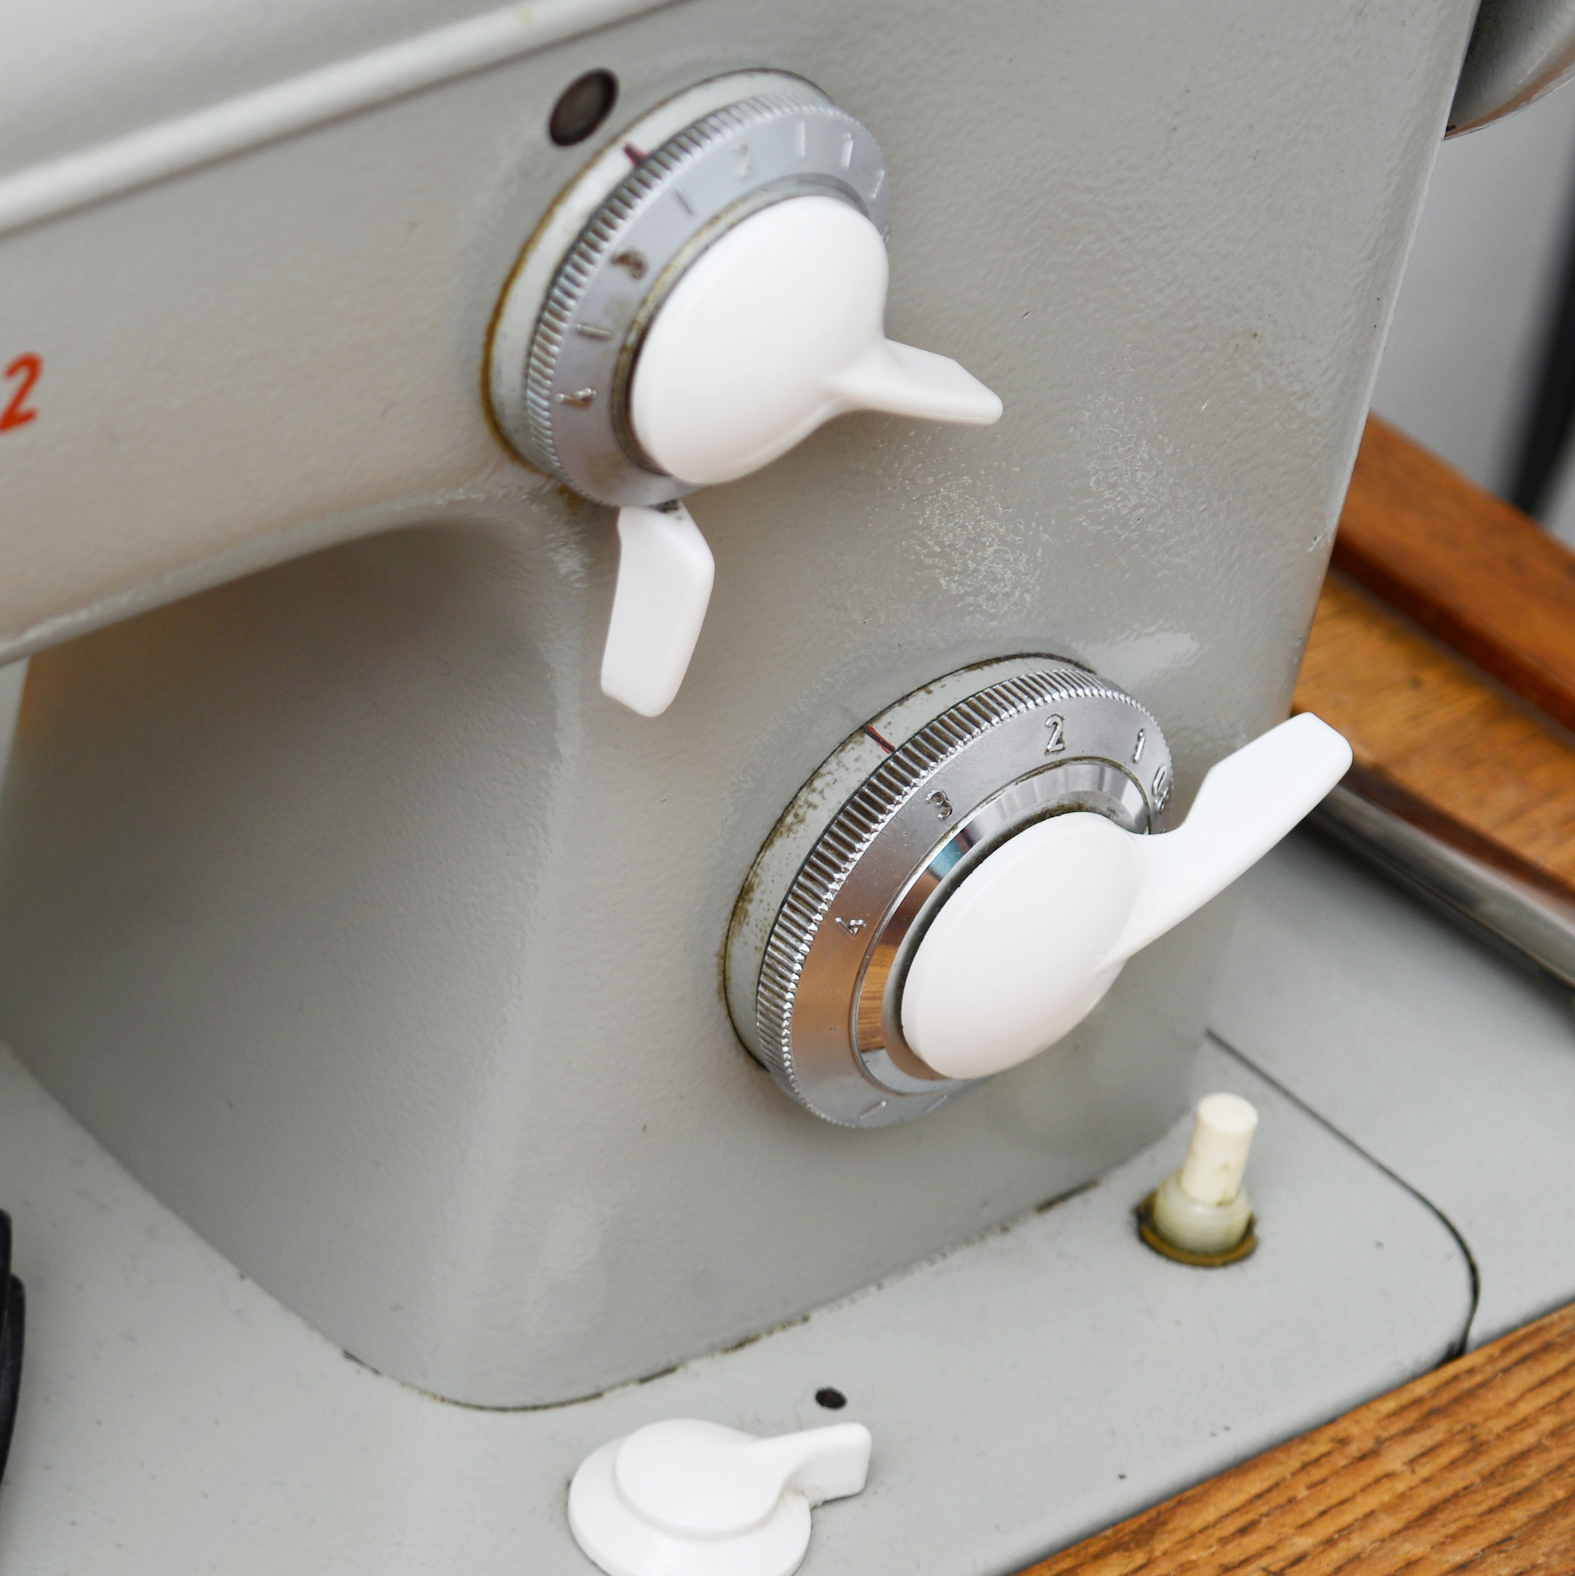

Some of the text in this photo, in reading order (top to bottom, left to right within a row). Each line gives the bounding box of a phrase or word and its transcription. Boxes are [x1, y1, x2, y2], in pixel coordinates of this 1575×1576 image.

[1044, 713, 1066, 754] 2
[1132, 729, 1146, 764] 1
[925, 789, 953, 821] 3
[834, 916, 867, 937] 4
